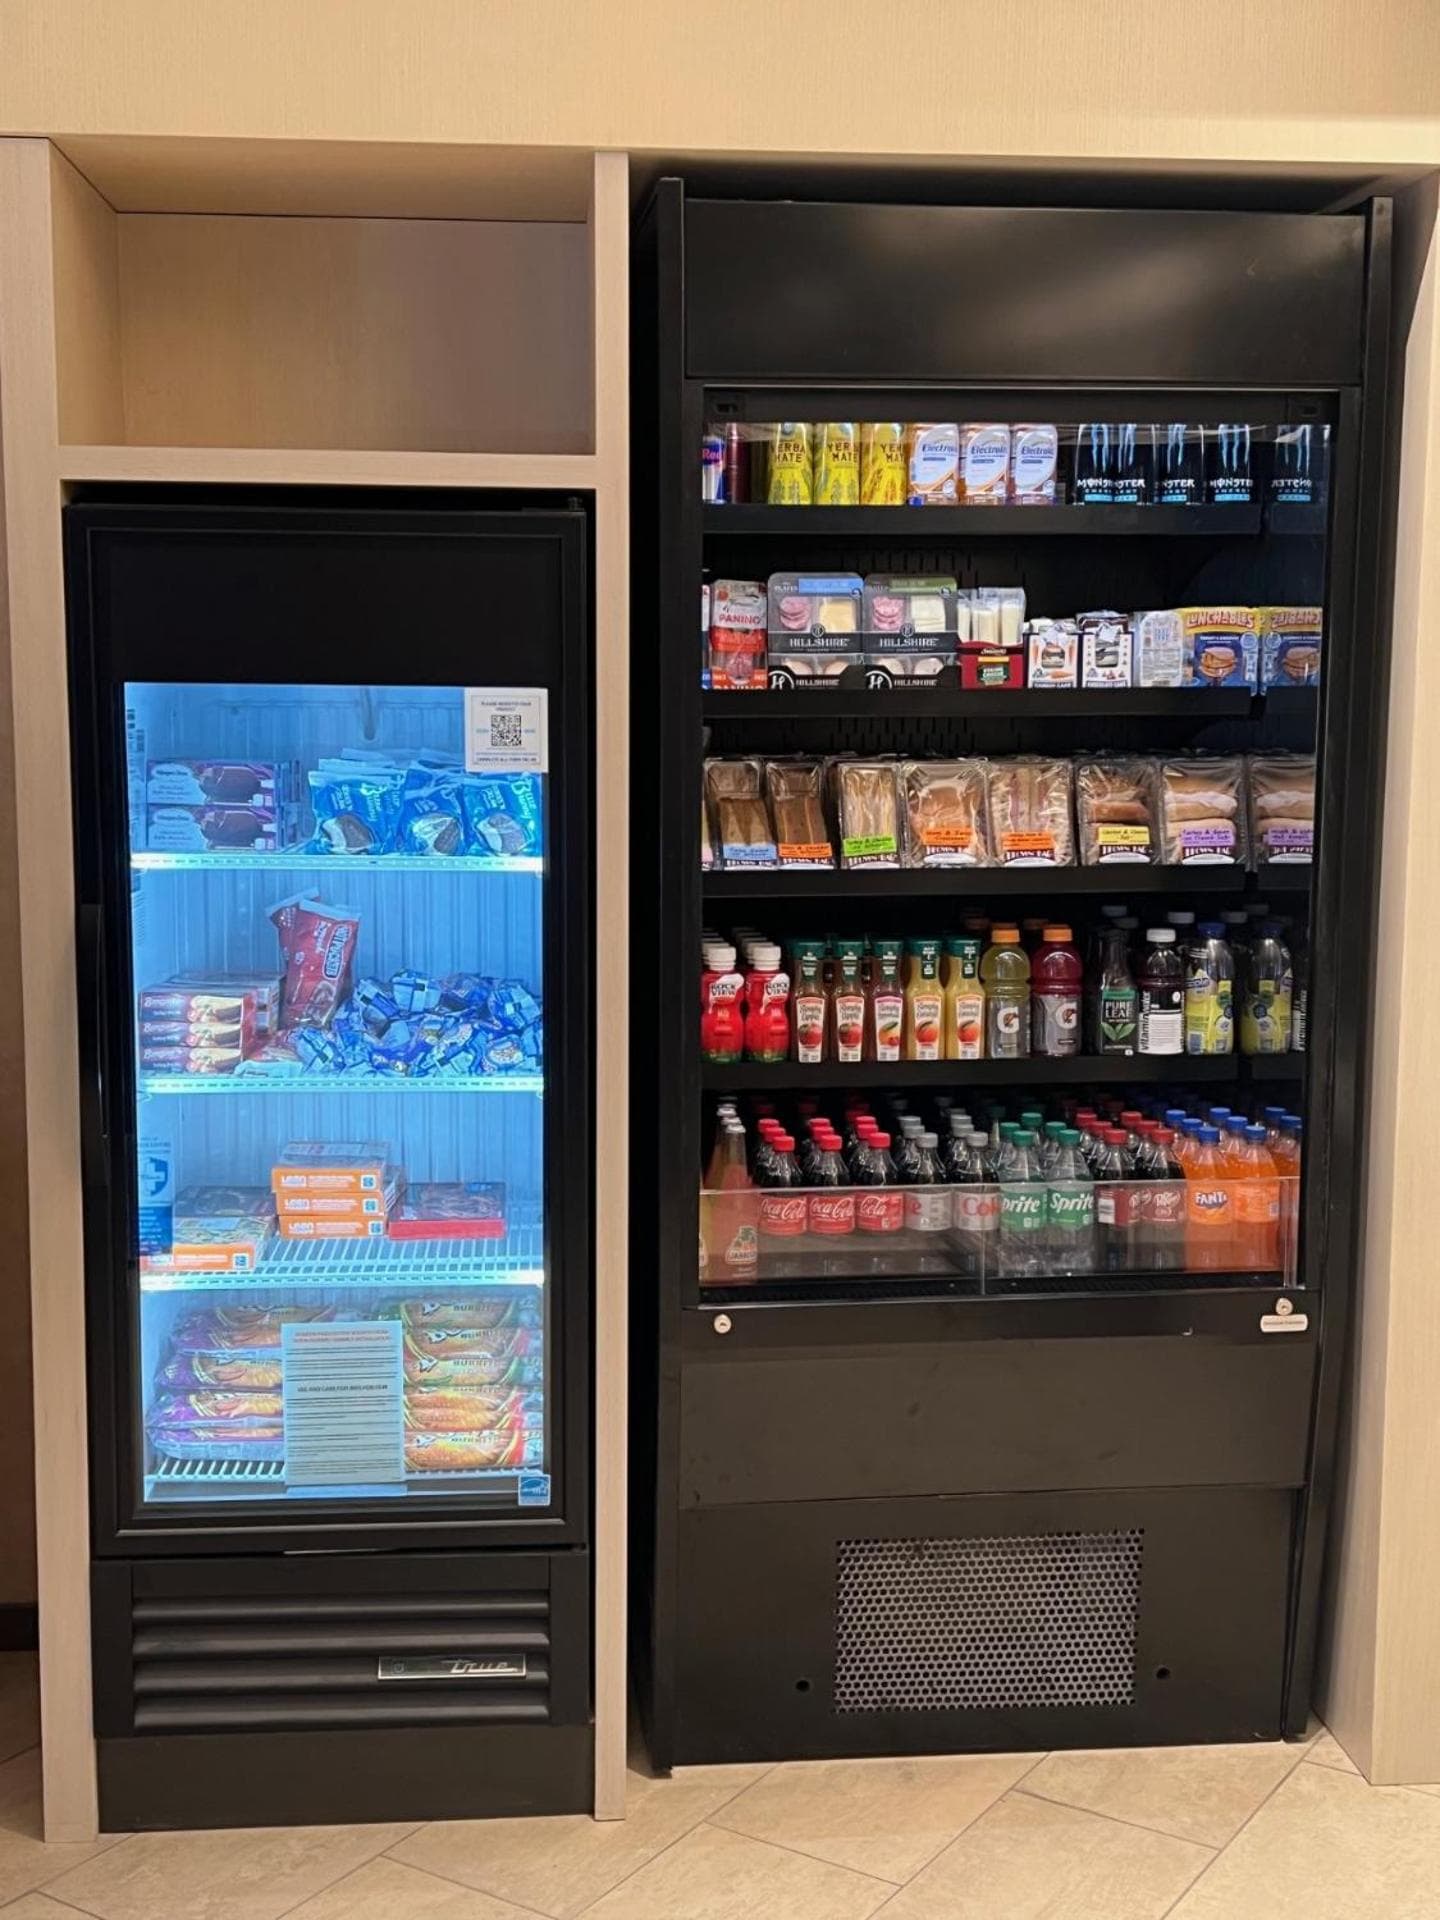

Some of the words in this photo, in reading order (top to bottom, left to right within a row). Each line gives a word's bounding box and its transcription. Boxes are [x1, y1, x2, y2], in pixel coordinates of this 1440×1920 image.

[1186, 610, 1254, 628] LUNCHABLES
[790, 638, 848, 647] HILLSHIRE
[880, 638, 938, 647] HILLSHIRE
[1105, 1001, 1132, 1009] PURE
[1105, 1008, 1132, 1018] LEAF
[441, 1659, 518, 1674] True
